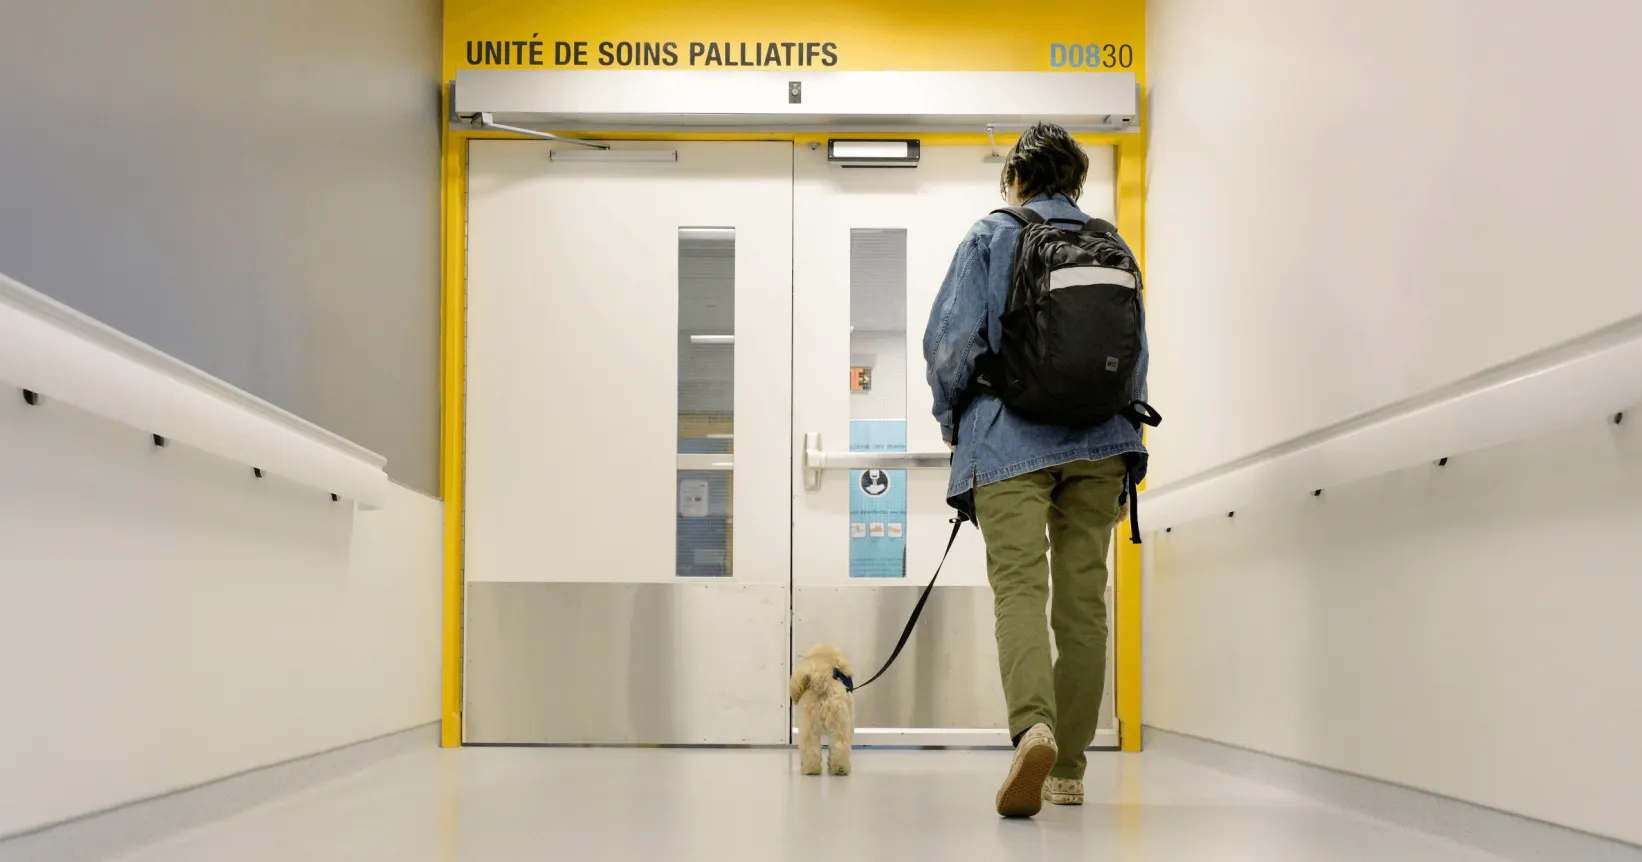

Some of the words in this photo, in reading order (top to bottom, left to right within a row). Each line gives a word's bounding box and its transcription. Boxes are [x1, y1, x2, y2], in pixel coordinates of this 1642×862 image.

[466, 32, 544, 66] UNITÉ
[554, 41, 588, 66] DE
[598, 41, 678, 66] SOINS
[689, 42, 838, 67] PALLIATIFS
[1050, 43, 1133, 68] D0830
